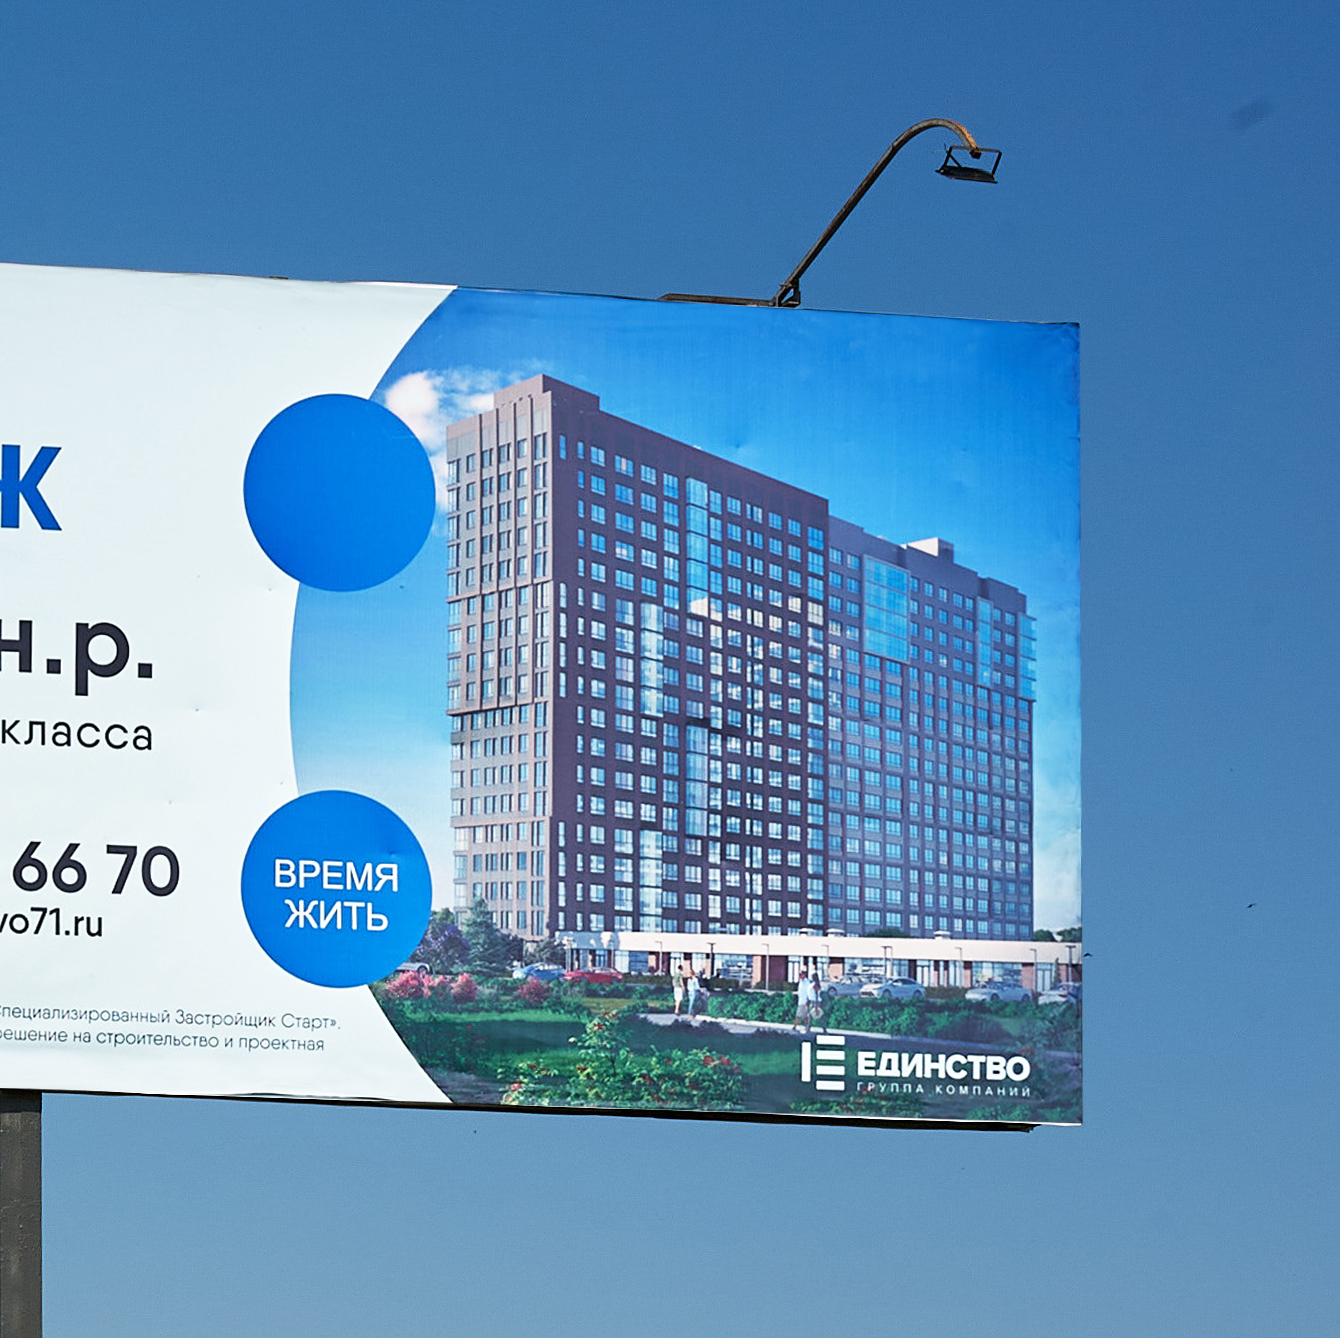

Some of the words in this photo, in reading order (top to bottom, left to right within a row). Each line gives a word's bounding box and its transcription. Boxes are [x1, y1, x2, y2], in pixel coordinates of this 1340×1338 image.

[13, 841, 87, 893] 66
[106, 844, 179, 897] 70
[275, 859, 398, 892] ВРЕМЯ
[284, 899, 389, 931] ЖИТЬ
[175, 1009, 275, 1028] Застройщик
[281, 1013, 340, 1031] Старт».
[73, 1032, 91, 1043] на
[96, 1032, 219, 1047] строительство
[225, 1038, 233, 1047] и
[239, 1038, 324, 1052] проектная
[857, 1051, 1031, 1081] ЕДИНСТВО
[857, 1082, 924, 1094] ГРУППА
[935, 1084, 1031, 1097] КОМПАНИЙ
